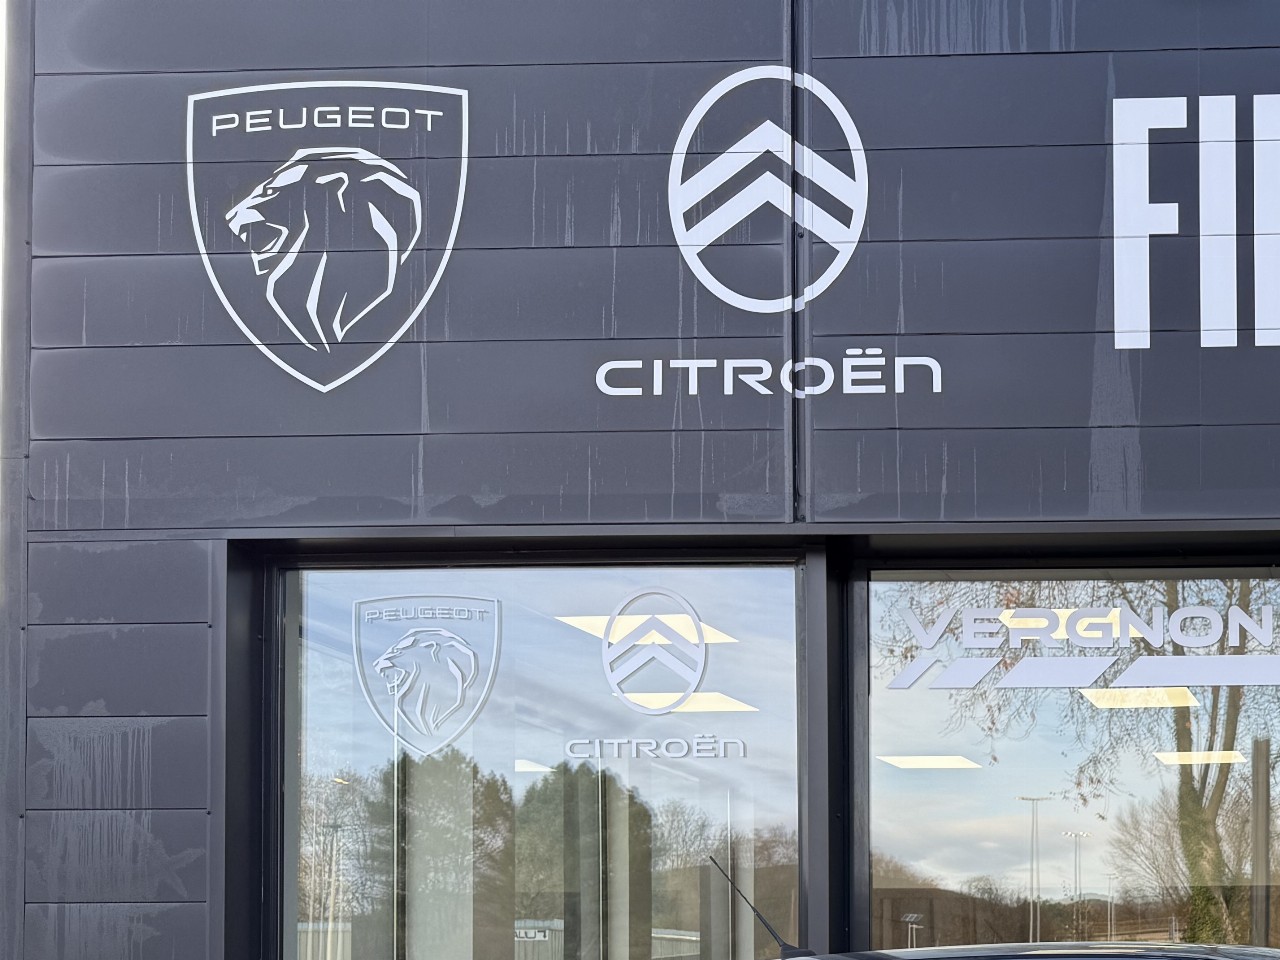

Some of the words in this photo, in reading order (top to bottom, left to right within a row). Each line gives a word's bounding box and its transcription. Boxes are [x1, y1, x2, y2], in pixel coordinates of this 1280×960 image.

[212, 106, 444, 137] PEUGEOT
[595, 347, 942, 399] CITROËN
[365, 606, 487, 622] PEUGEOT
[900, 604, 1274, 649] VERGNON
[565, 734, 746, 758] CITROËN
